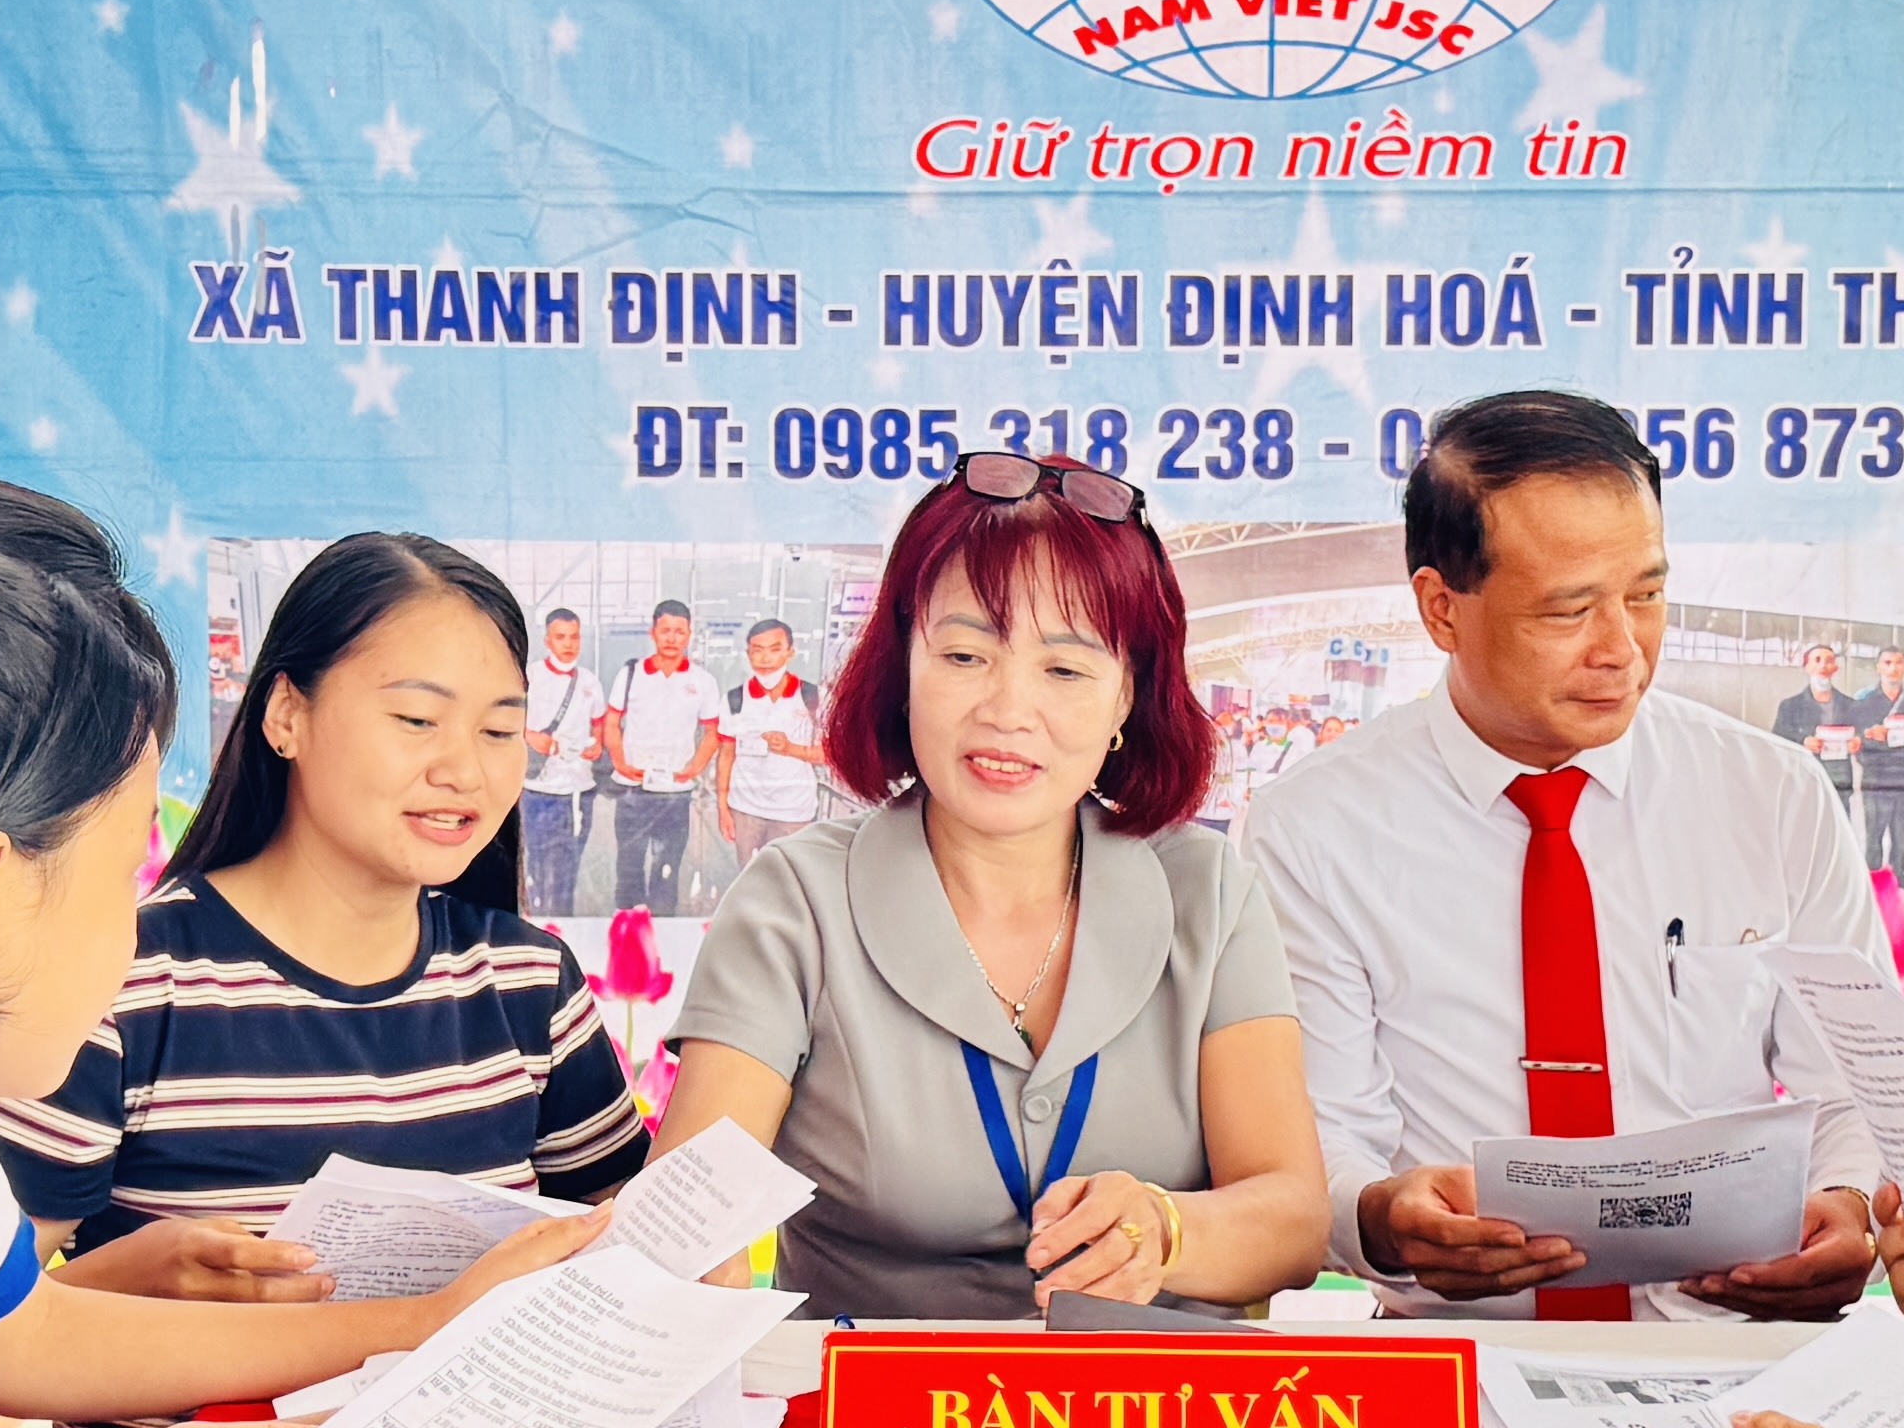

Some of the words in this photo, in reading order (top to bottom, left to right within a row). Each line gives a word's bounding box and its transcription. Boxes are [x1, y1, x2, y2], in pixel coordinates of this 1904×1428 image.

[1375, 2, 1473, 55] JSC
[917, 120, 1069, 177] Giữ
[1092, 127, 1253, 193] trọn
[1286, 110, 1491, 176] niềm
[1530, 121, 1626, 175] tin
[195, 252, 300, 338] XÃ
[328, 269, 579, 343] THANH
[609, 273, 796, 361] ĐỊNH
[885, 259, 1137, 363] HUYỆN
[1167, 276, 1352, 363] ĐỊNH
[1387, 257, 1540, 345] HOÁ
[1627, 247, 1803, 344] TỈNH
[635, 407, 742, 477] ĐT:
[775, 408, 960, 479] 0985
[990, 409, 1127, 476] 318
[1158, 409, 1293, 479] 238
[1622, 408, 1734, 479] 56
[1766, 408, 1904, 477] 873
